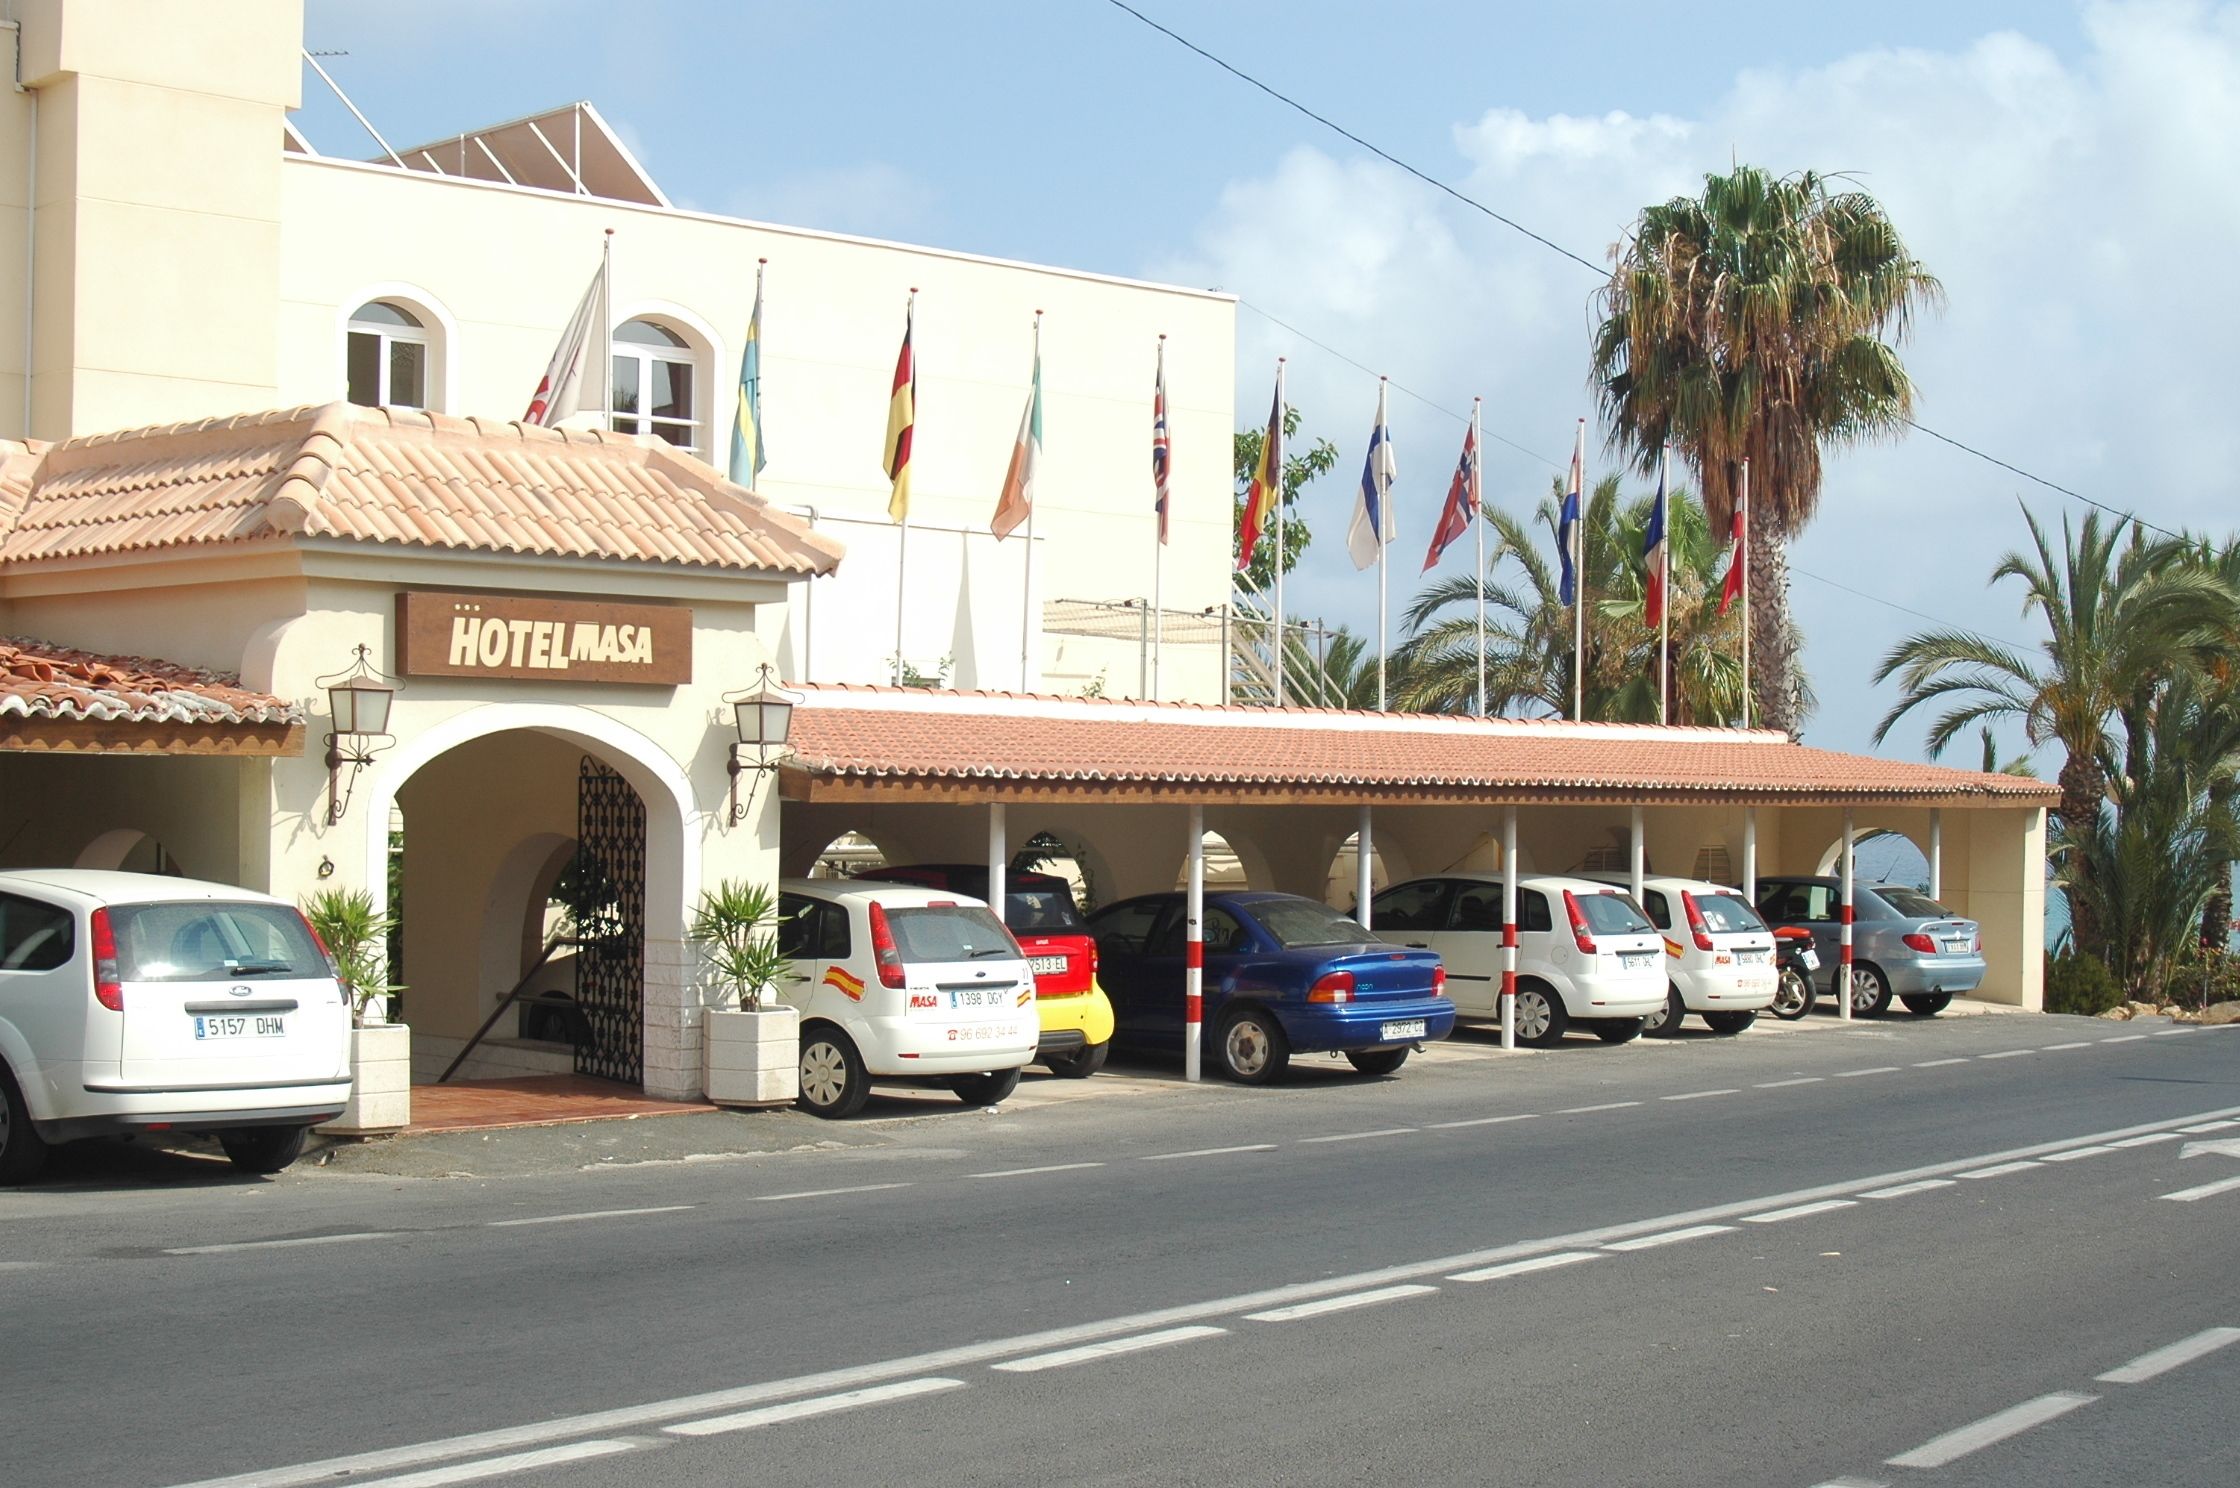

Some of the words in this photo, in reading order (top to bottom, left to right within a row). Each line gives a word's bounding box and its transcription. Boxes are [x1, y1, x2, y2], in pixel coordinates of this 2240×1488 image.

[449, 617, 569, 669] HOTEL
[569, 621, 653, 664] MASA
[1055, 957, 1066, 970] EL
[909, 994, 938, 1009] MASA
[960, 992, 983, 1006] 1398
[987, 991, 1003, 1005] DGY
[208, 1018, 246, 1036] 5157
[256, 1017, 284, 1035] DHM
[960, 1028, 973, 1041] 96
[975, 1027, 993, 1040] 692
[1392, 1021, 1412, 1035] 2972
